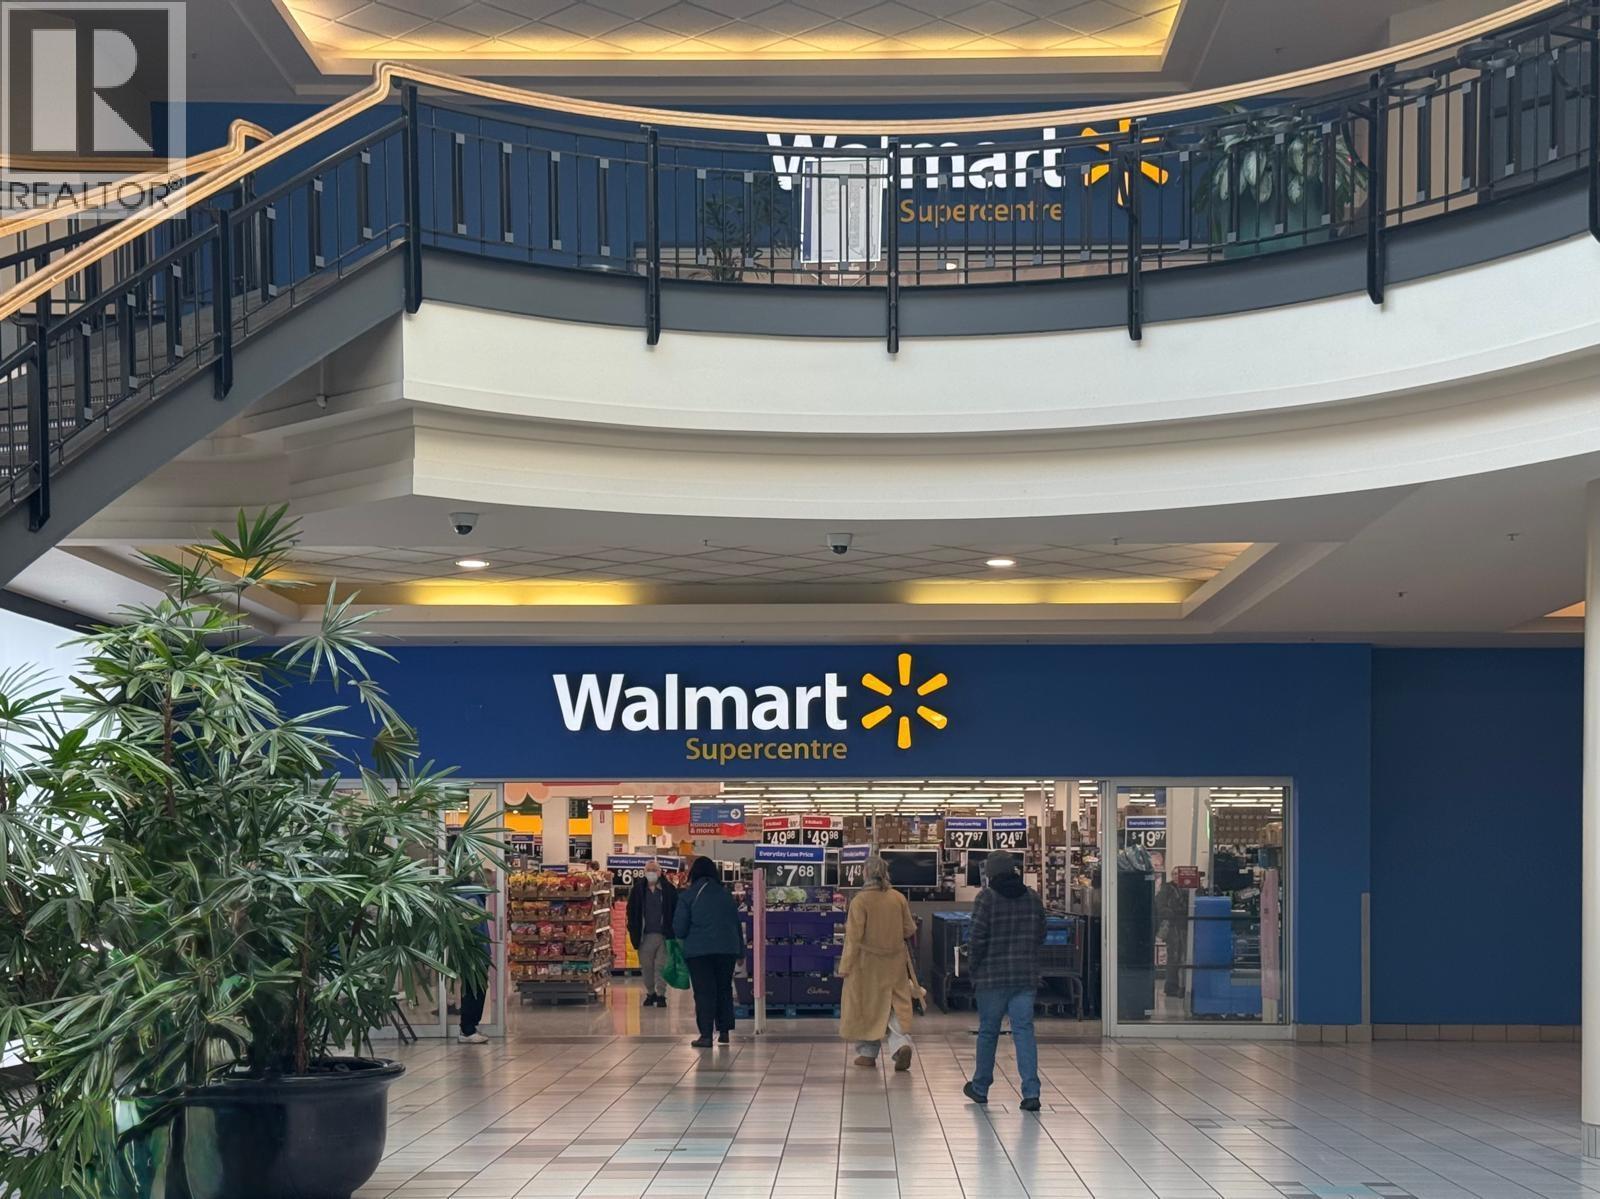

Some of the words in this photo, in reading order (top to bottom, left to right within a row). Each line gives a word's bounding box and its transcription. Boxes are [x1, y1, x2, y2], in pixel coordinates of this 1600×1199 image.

[899, 199, 1062, 229] Supercentre
[552, 673, 847, 732] Walmart
[686, 737, 847, 765] Supercentre
[759, 850, 786, 858] Everyday
